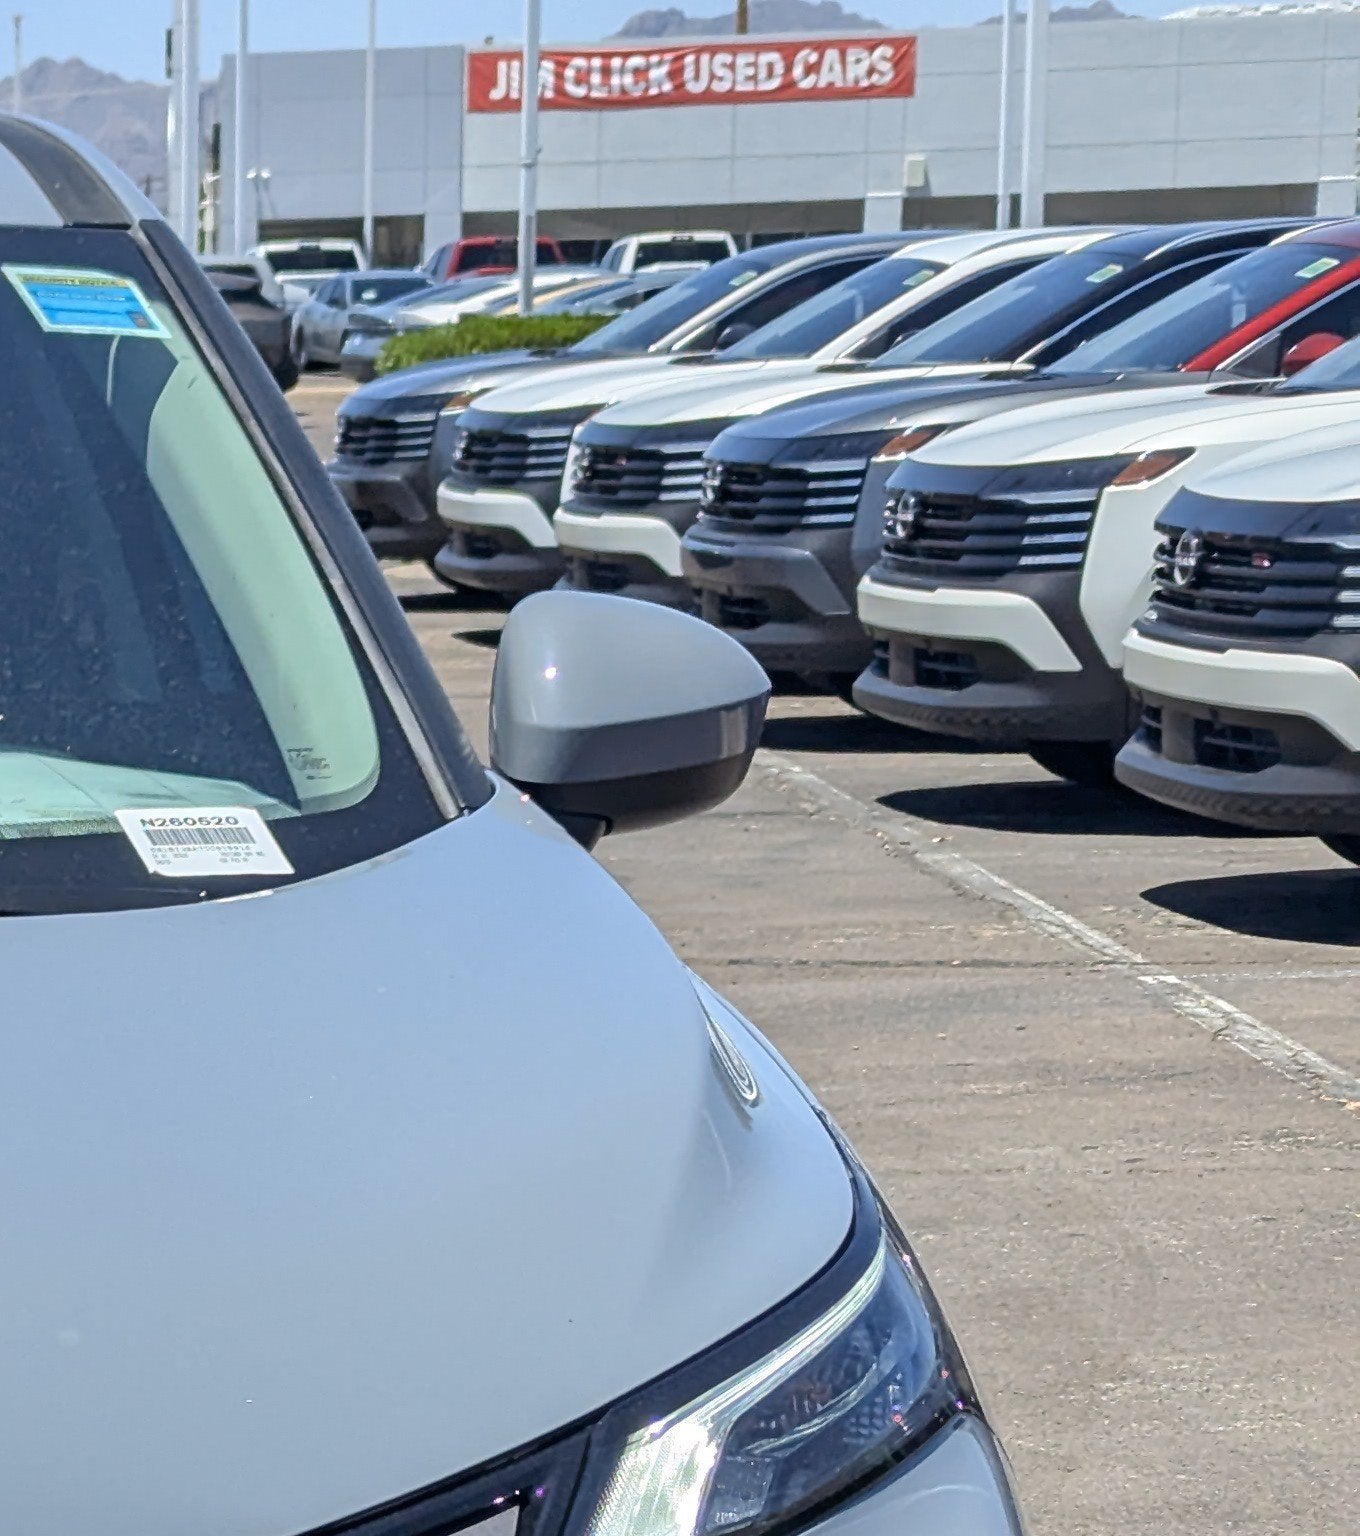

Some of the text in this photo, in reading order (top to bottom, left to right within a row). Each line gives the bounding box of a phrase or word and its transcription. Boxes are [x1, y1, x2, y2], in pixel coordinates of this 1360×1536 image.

[563, 52, 674, 99] CLICK
[682, 49, 785, 94] USED
[791, 44, 897, 89] CARS
[139, 815, 240, 828] N260520
